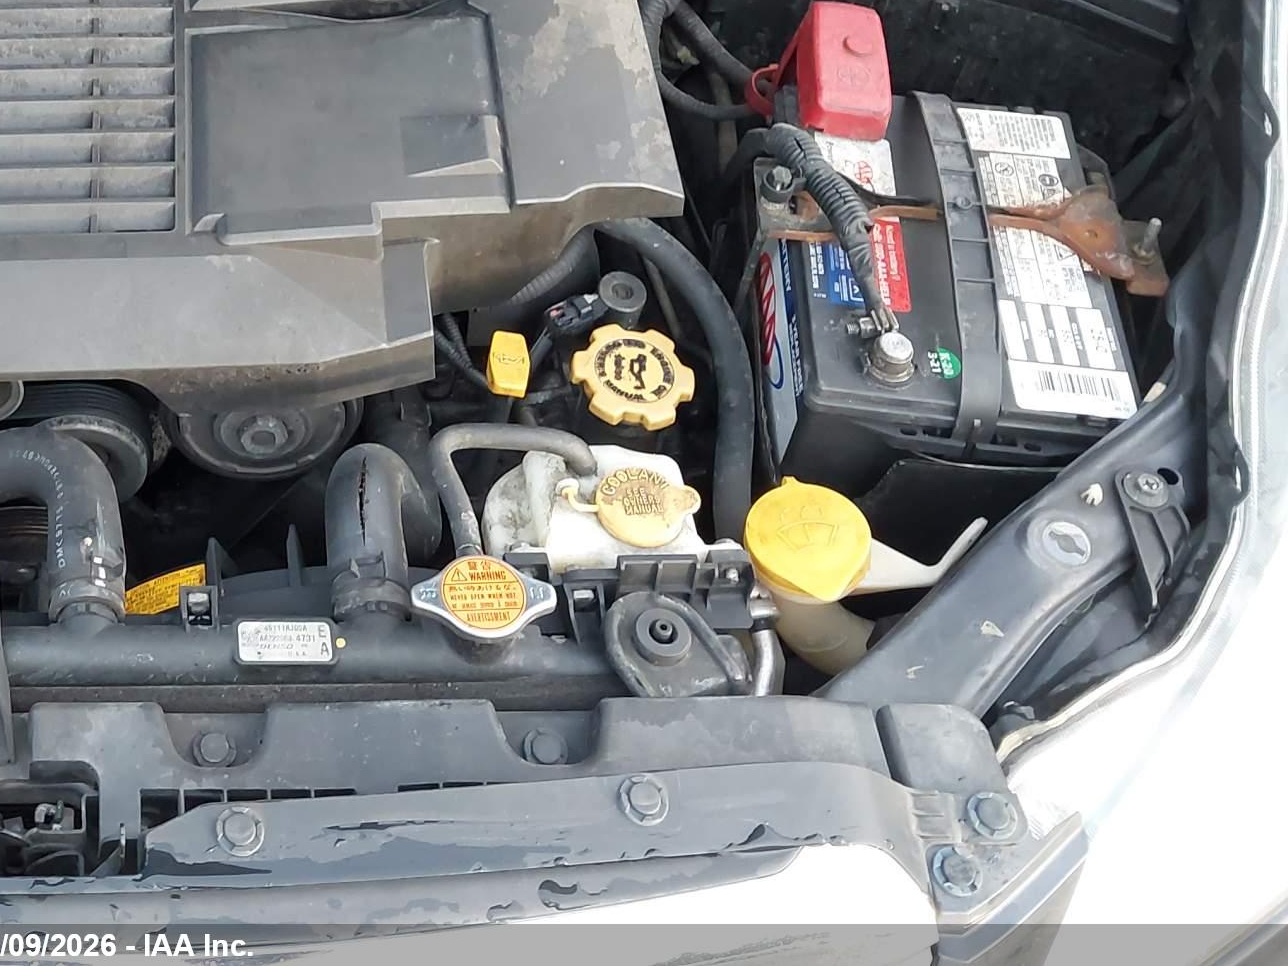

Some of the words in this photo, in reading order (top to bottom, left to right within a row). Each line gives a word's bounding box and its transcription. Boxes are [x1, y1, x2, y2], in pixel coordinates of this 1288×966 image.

[601, 469, 670, 496] COOLANT
[626, 488, 646, 497] SEE
[469, 571, 506, 581] WARNING
[318, 625, 327, 638] E
[320, 641, 330, 656] A
